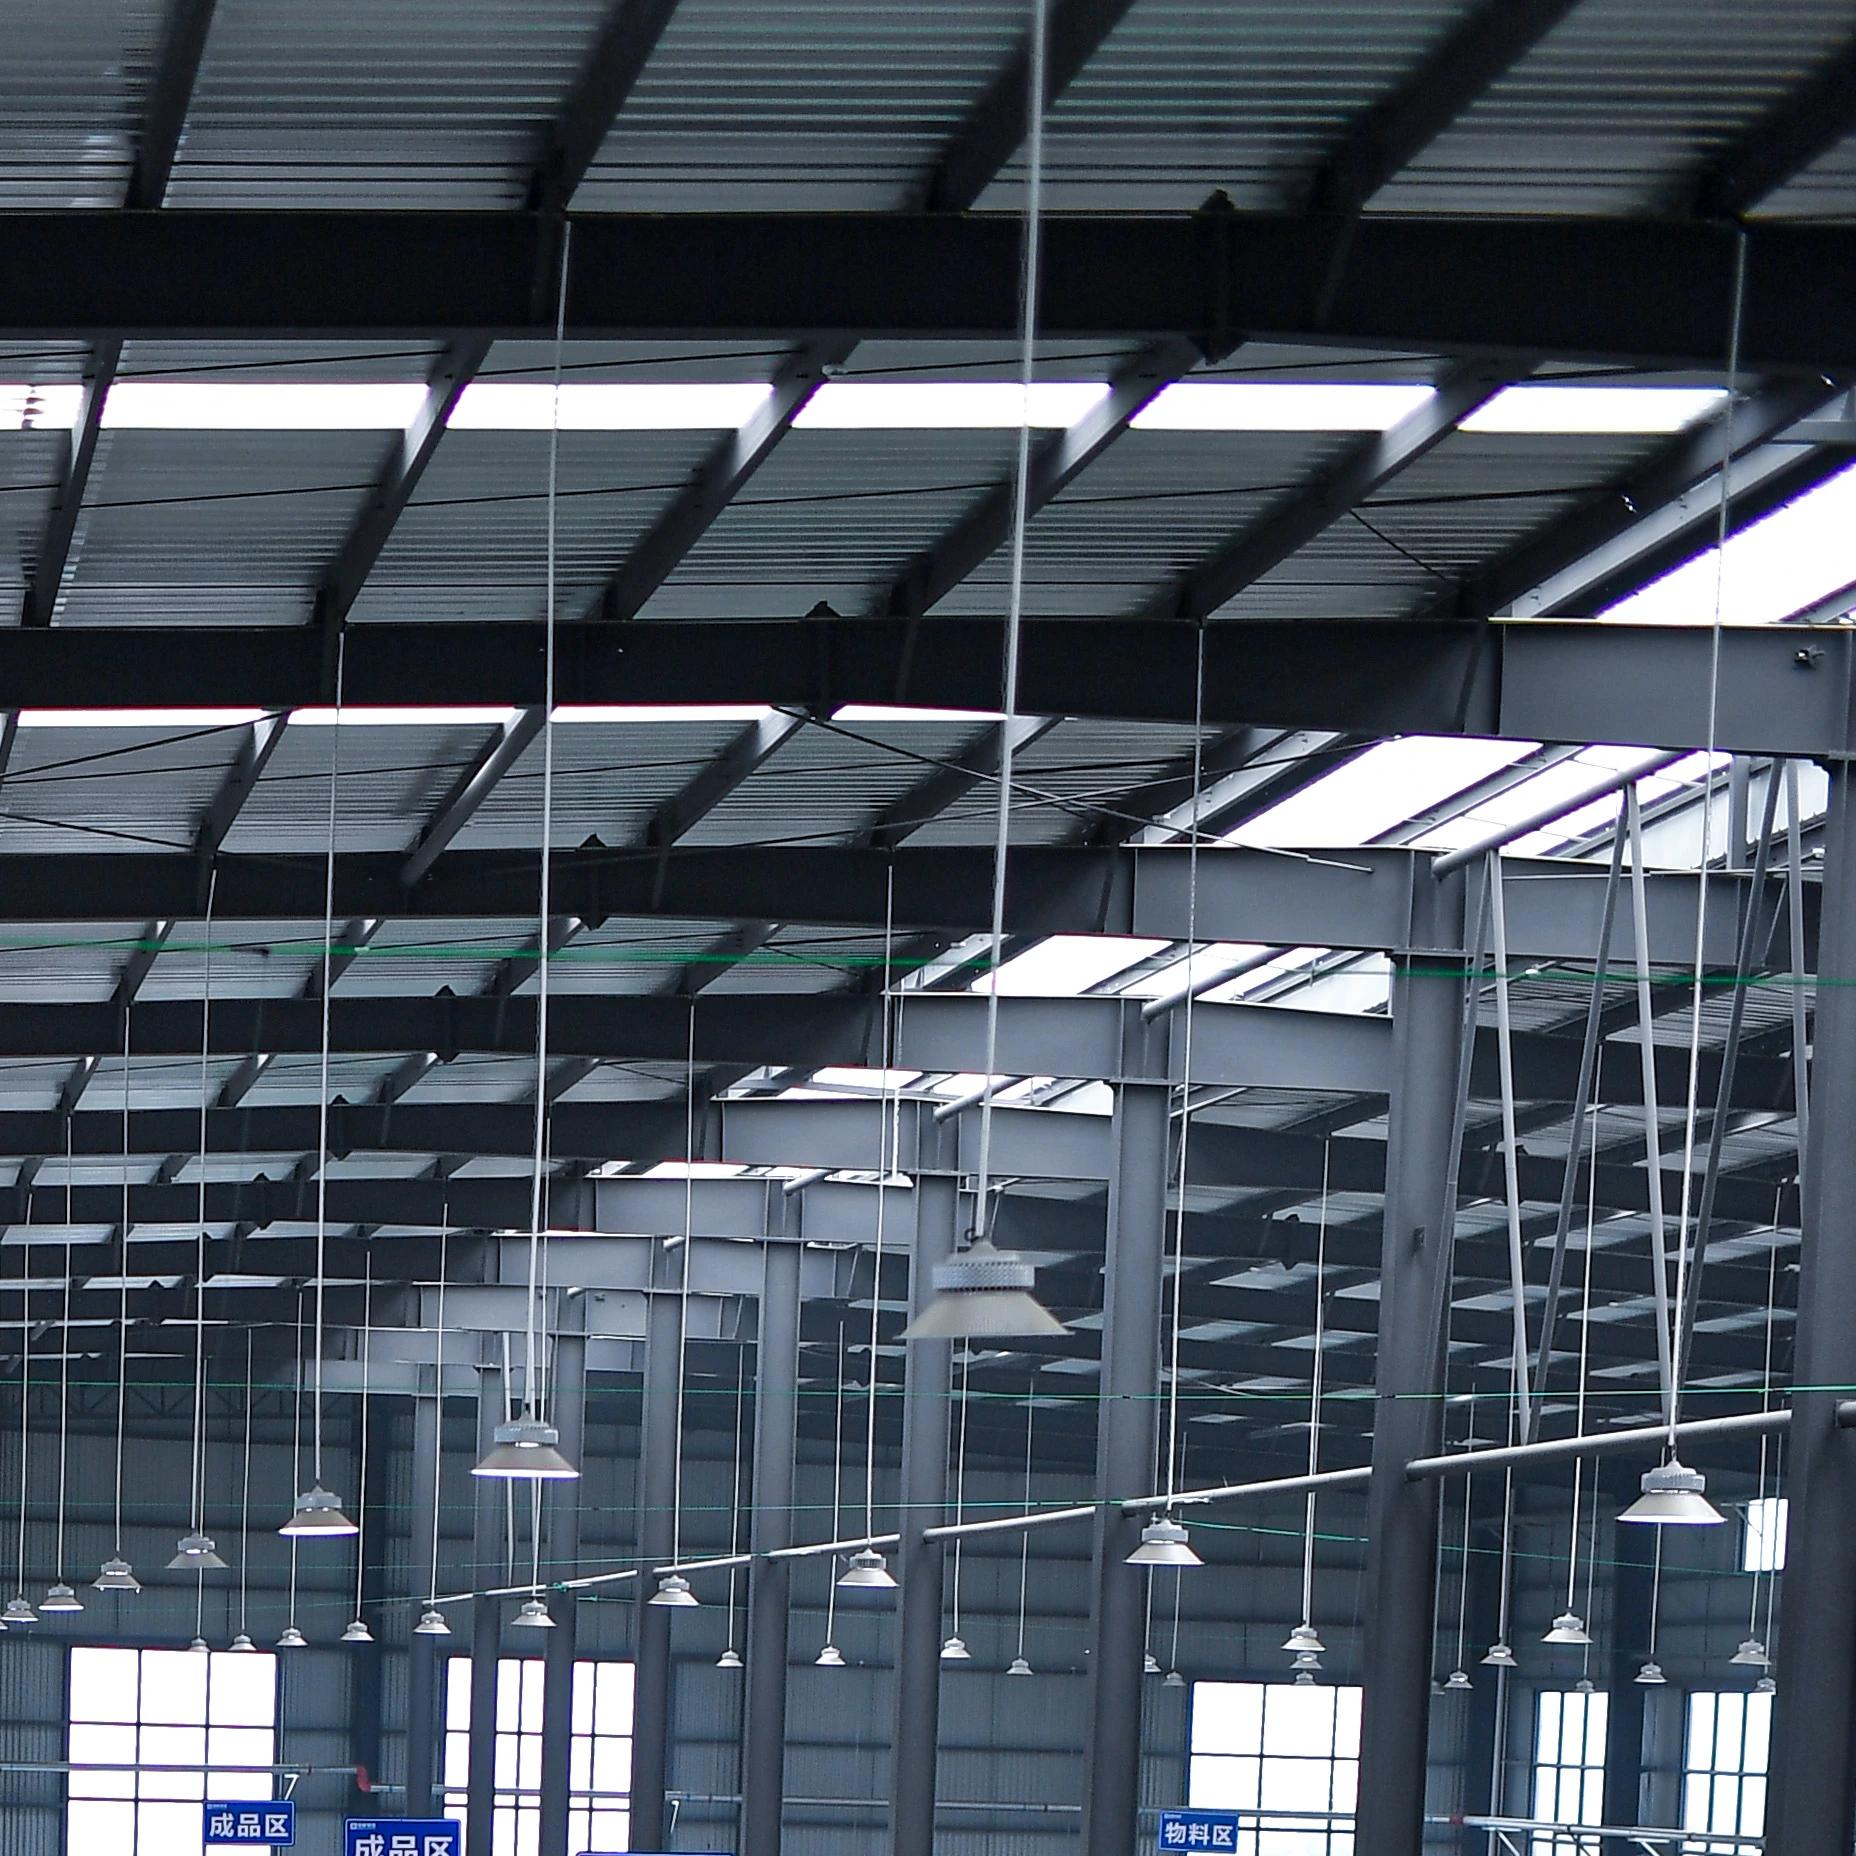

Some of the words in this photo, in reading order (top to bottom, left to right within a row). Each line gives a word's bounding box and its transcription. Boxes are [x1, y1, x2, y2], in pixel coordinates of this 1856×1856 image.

[209, 1812, 289, 1838] 成品区
[1165, 1822, 1234, 1846] 物料区
